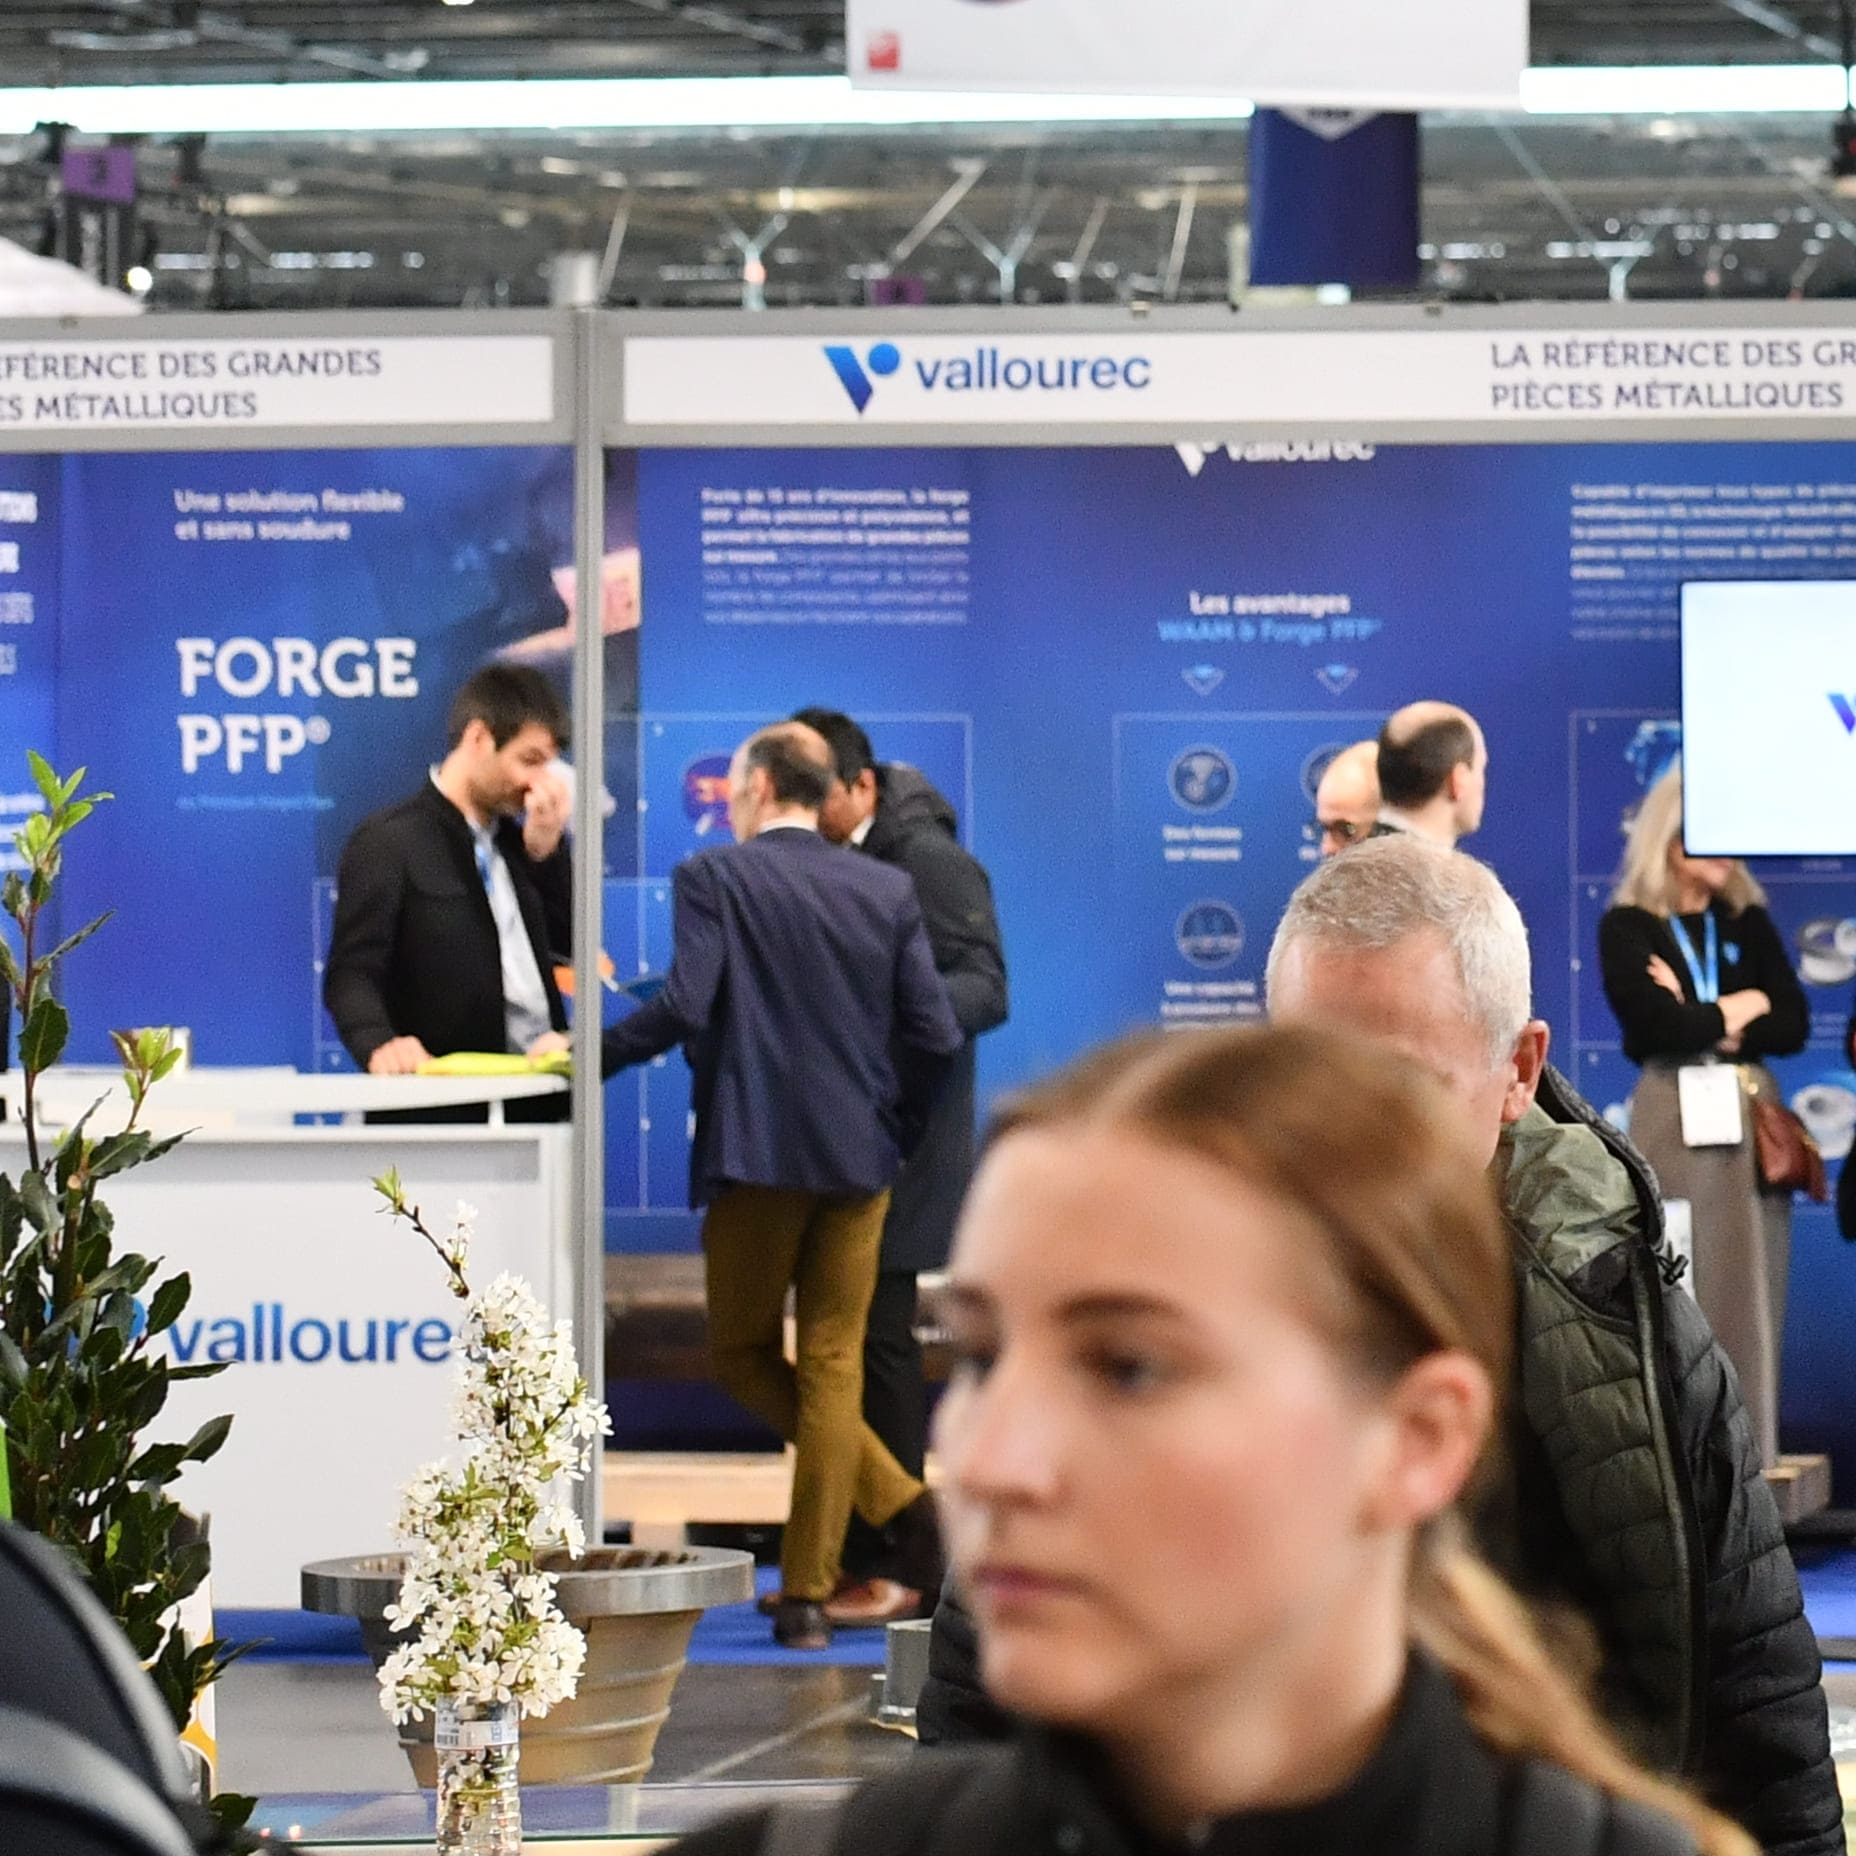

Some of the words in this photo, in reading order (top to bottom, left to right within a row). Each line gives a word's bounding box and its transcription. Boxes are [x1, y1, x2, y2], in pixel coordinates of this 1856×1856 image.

[0, 348, 149, 381] FÉRENCE
[158, 350, 217, 380] DES
[227, 347, 383, 378] GRANDES
[914, 346, 1153, 392] vallourec
[1490, 343, 1531, 369] LA
[1542, 337, 1732, 369] RÉFÉRENCE
[1743, 340, 1803, 368] DES
[35, 390, 259, 421] MÉTALLIQUES
[1490, 380, 1604, 411] PIÈCES
[1613, 378, 1845, 411] MÉTALLIQUES
[176, 637, 419, 699] FORGE
[165, 1301, 486, 1364] valloure
